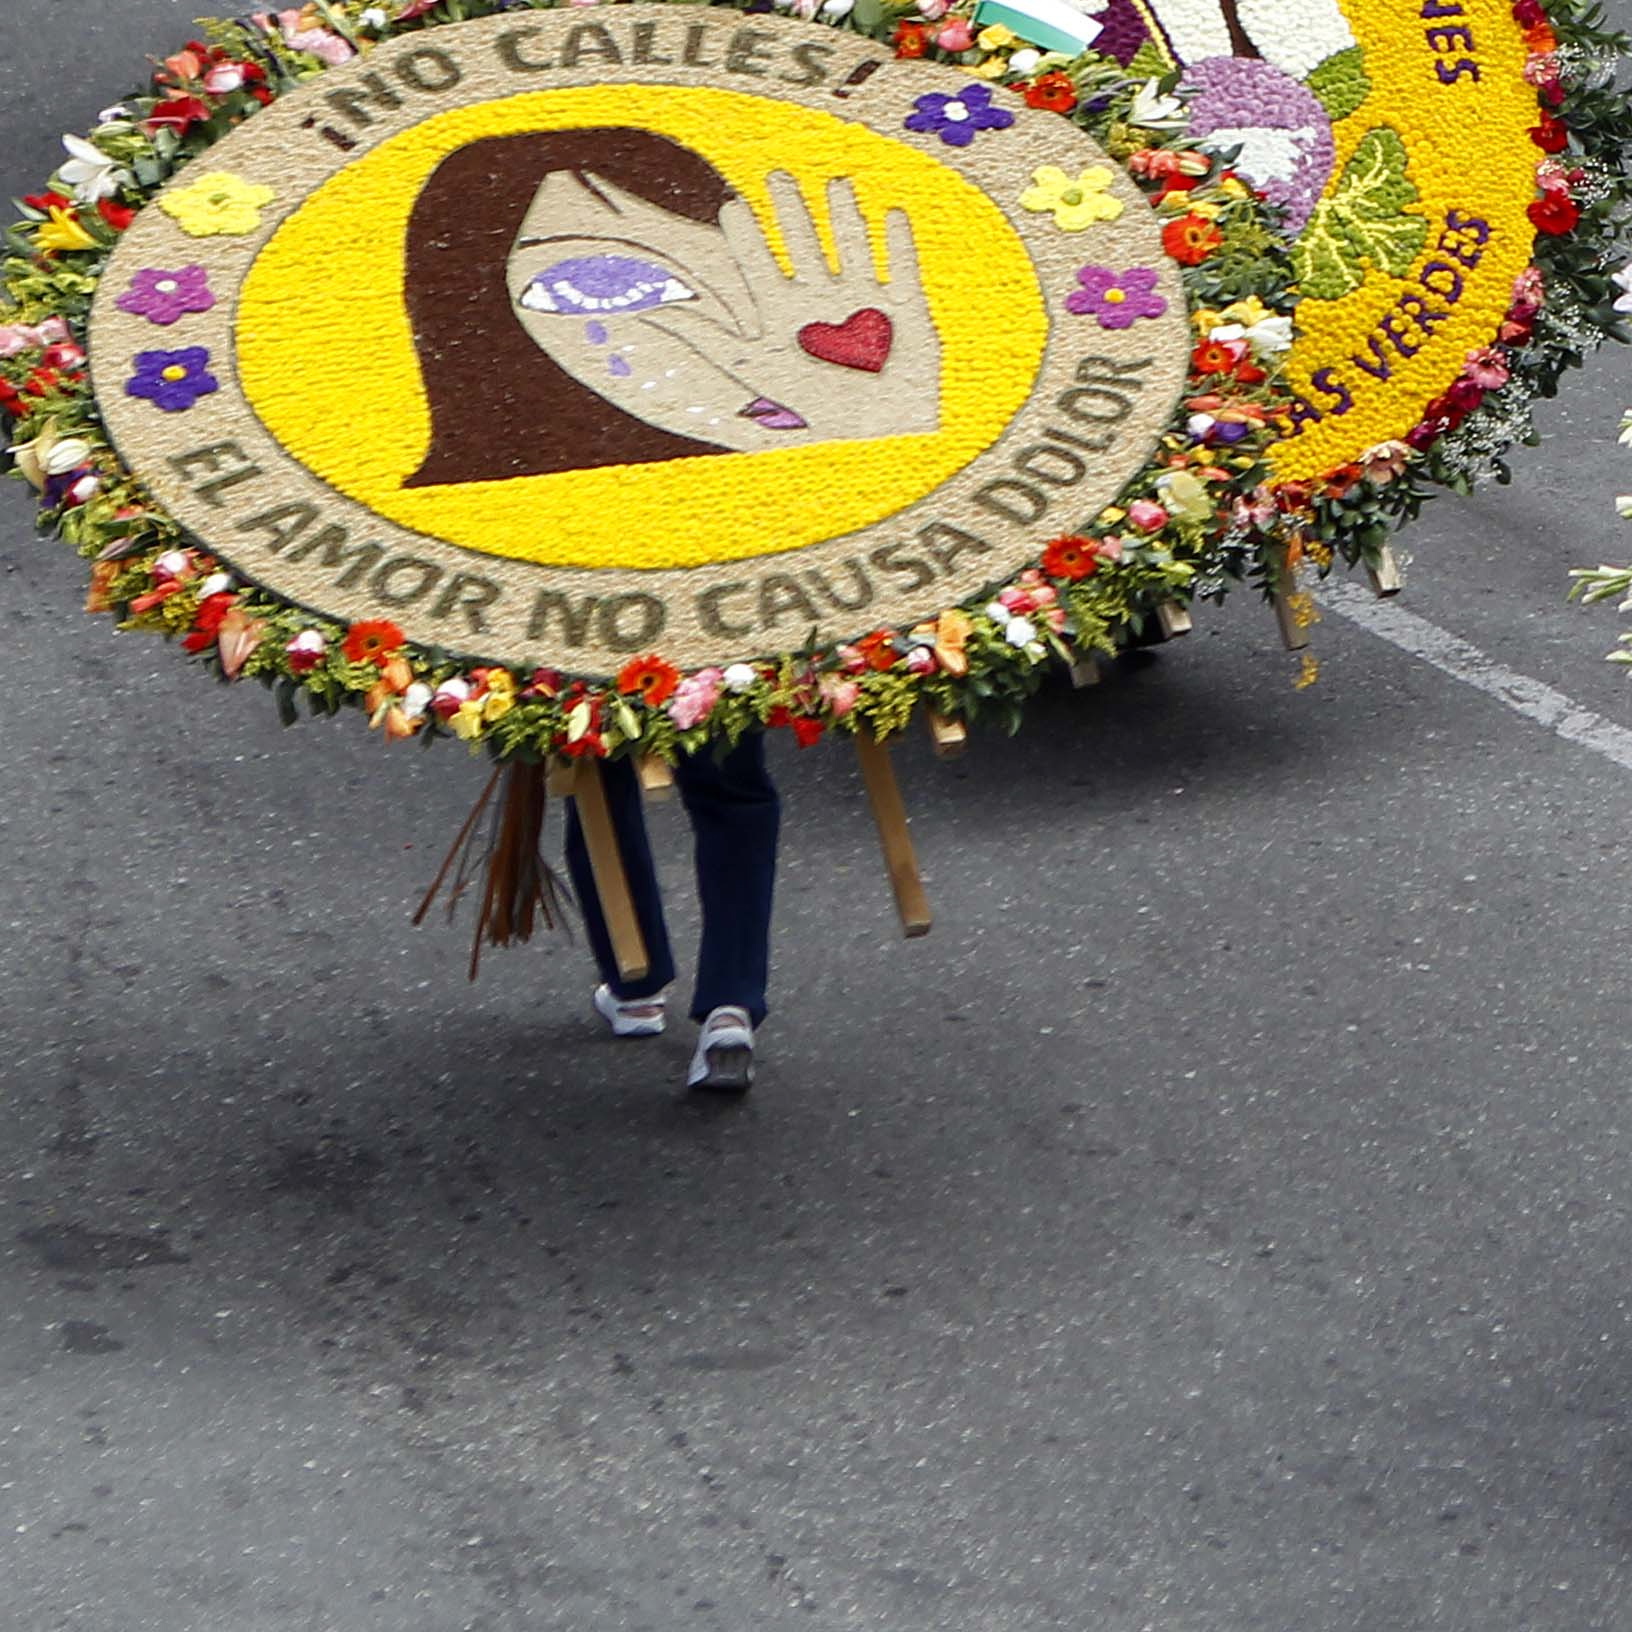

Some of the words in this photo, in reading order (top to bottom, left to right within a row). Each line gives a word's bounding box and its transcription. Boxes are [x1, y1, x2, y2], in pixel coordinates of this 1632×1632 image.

[496, 19, 882, 99] CALLES!
[1353, 208, 1492, 382] VERDES
[164, 438, 264, 508] EL
[233, 500, 503, 634] AMOR
[525, 588, 667, 653] NO
[698, 521, 994, 640] CAUSA
[971, 355, 1156, 528] DOLOR
